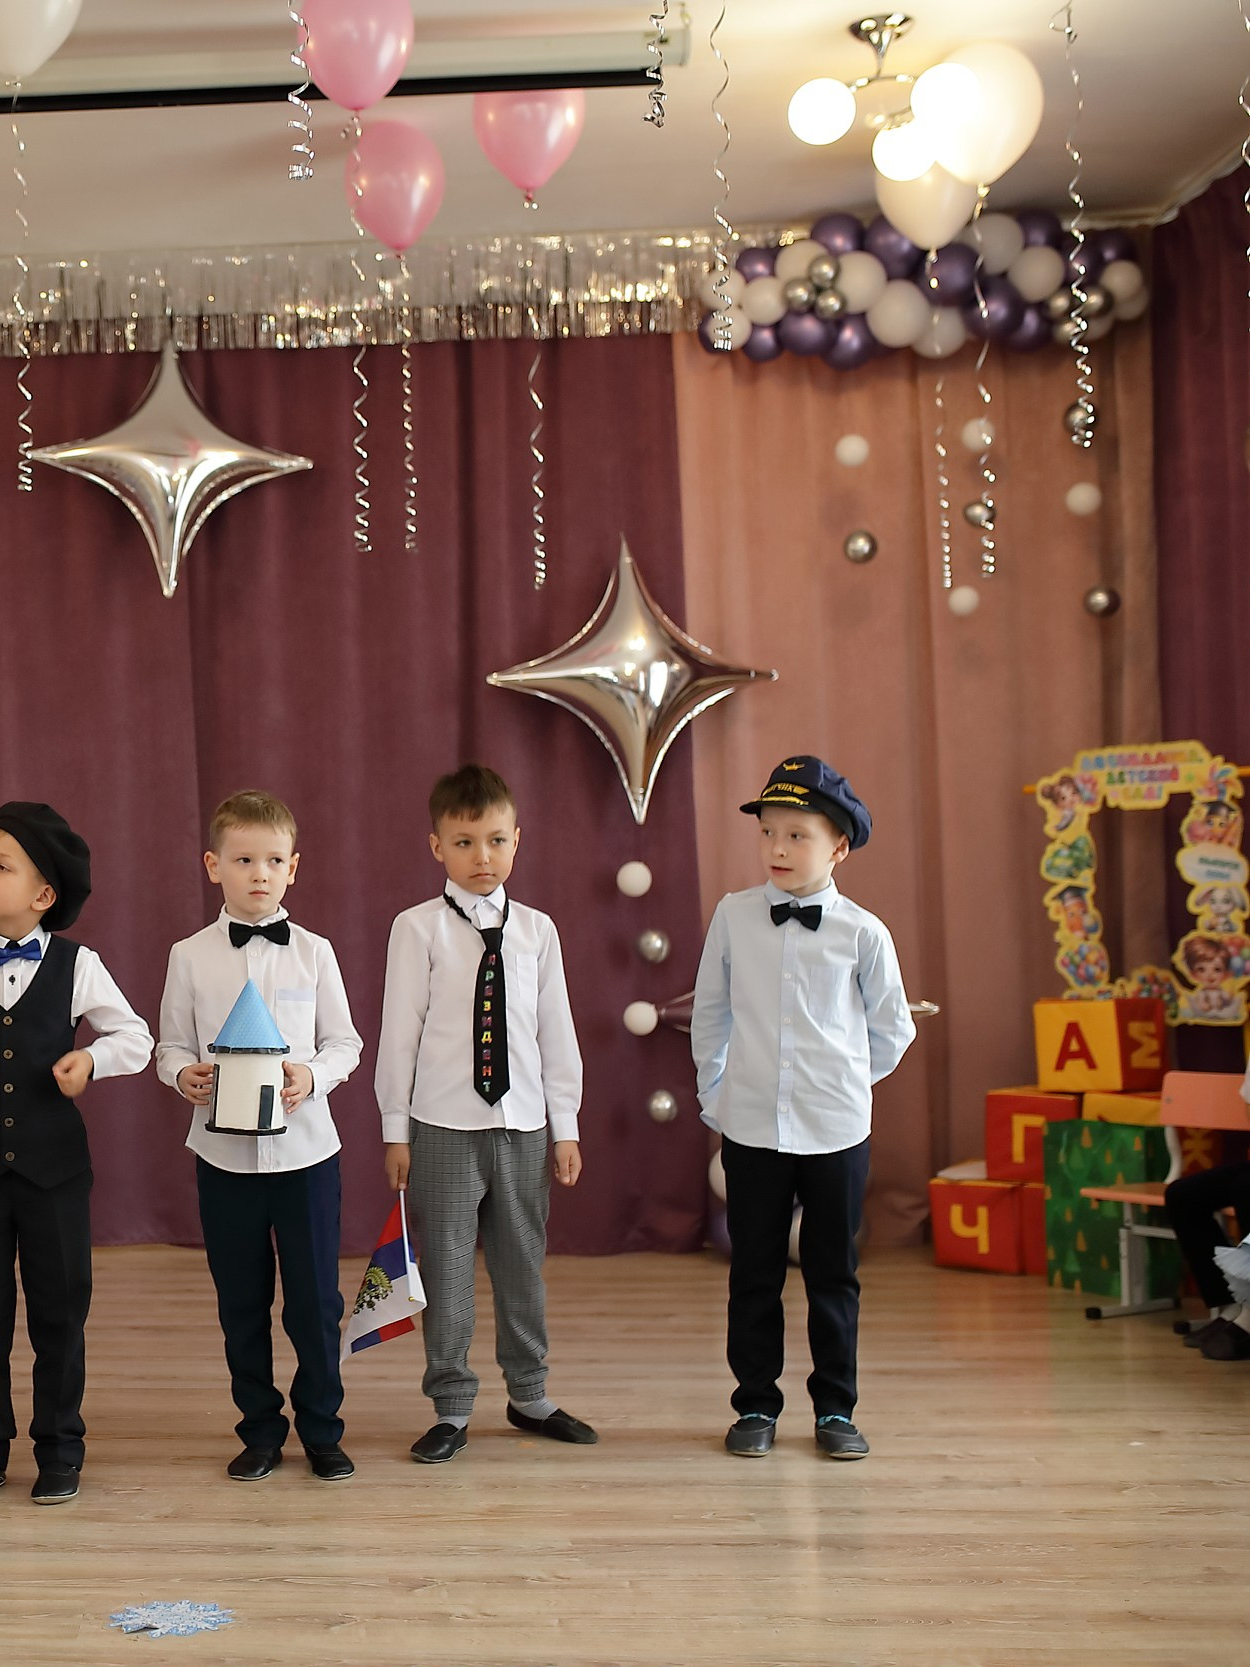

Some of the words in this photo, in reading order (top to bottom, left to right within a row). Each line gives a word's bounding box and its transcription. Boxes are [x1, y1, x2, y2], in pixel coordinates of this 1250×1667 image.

[480, 953, 497, 1093] ПРЕЗИДЕНТ
[1054, 1021, 1098, 1072] А
[950, 1203, 991, 1255] Ч
